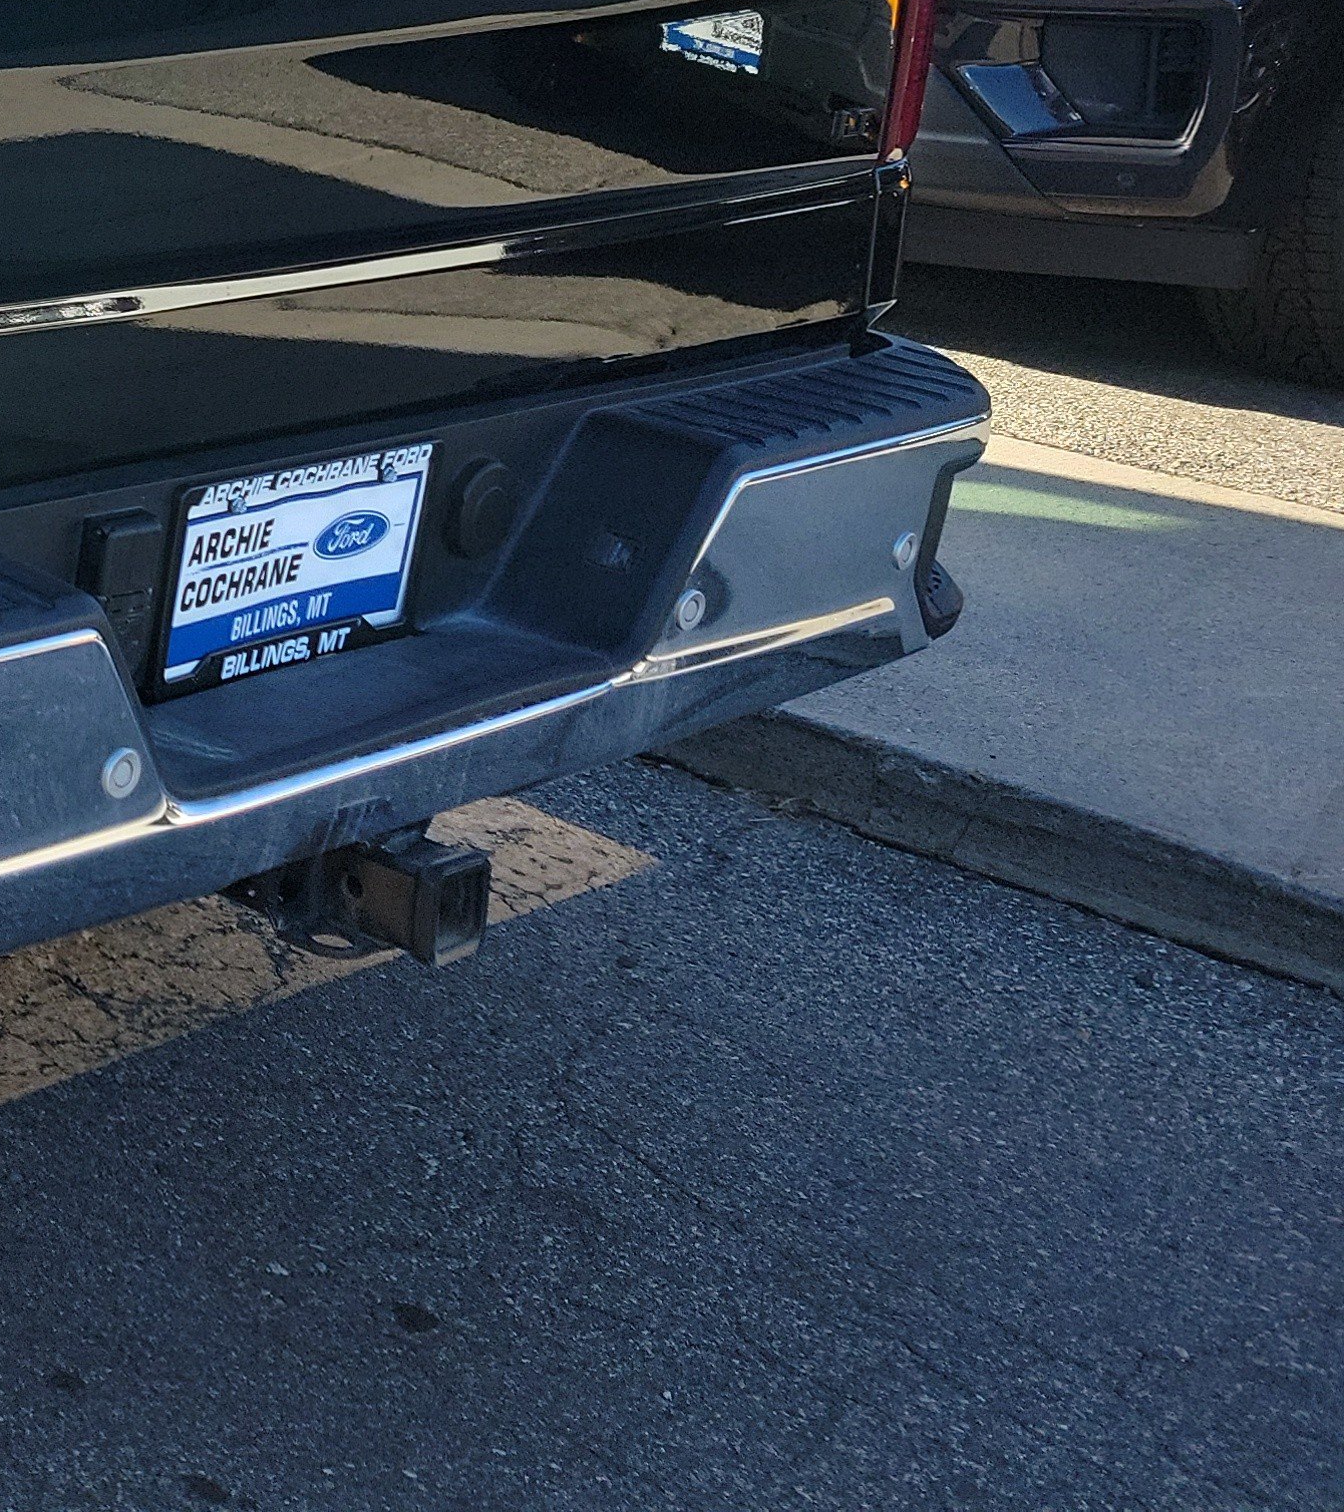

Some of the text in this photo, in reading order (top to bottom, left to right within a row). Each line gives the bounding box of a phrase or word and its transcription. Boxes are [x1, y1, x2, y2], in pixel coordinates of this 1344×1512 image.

[200, 443, 434, 506] ARCHIE COCHRANE FORD
[187, 518, 276, 568] ARCHIE
[326, 518, 373, 552] Ford
[179, 553, 304, 613] COCHRANE
[230, 592, 333, 642] BILLINGS, MT
[220, 627, 351, 681] BILLINGS, MT
